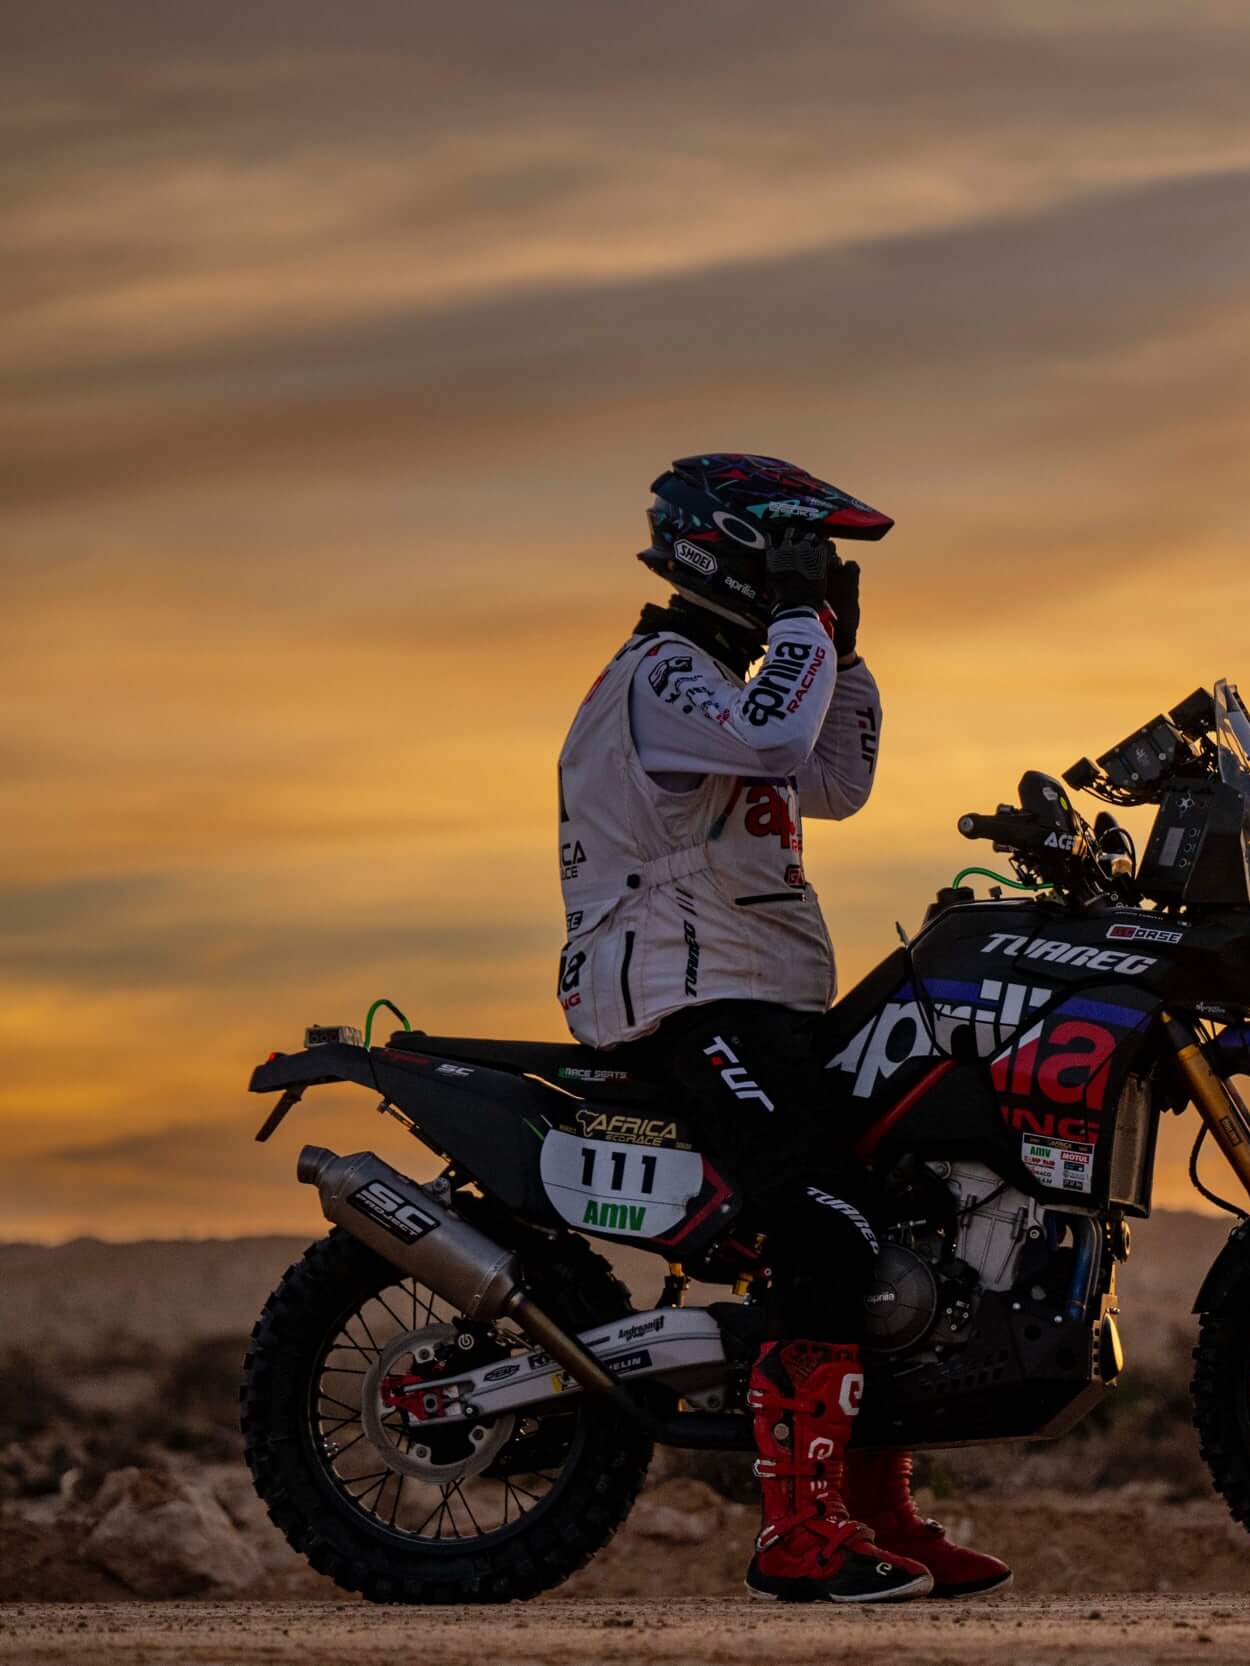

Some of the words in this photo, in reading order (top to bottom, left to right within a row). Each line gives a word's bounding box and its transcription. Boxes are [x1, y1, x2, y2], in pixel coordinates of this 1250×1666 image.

[679, 544, 711, 570] SHOEI
[724, 576, 757, 600] aprilia
[742, 641, 812, 726] aprilia
[786, 646, 826, 714] RACING
[980, 932, 1159, 976] TUAREG
[586, 1112, 679, 1140] AFRICA
[582, 1147, 657, 1194] 111
[1062, 1152, 1089, 1163] MOTUL
[359, 1182, 437, 1234] SC
